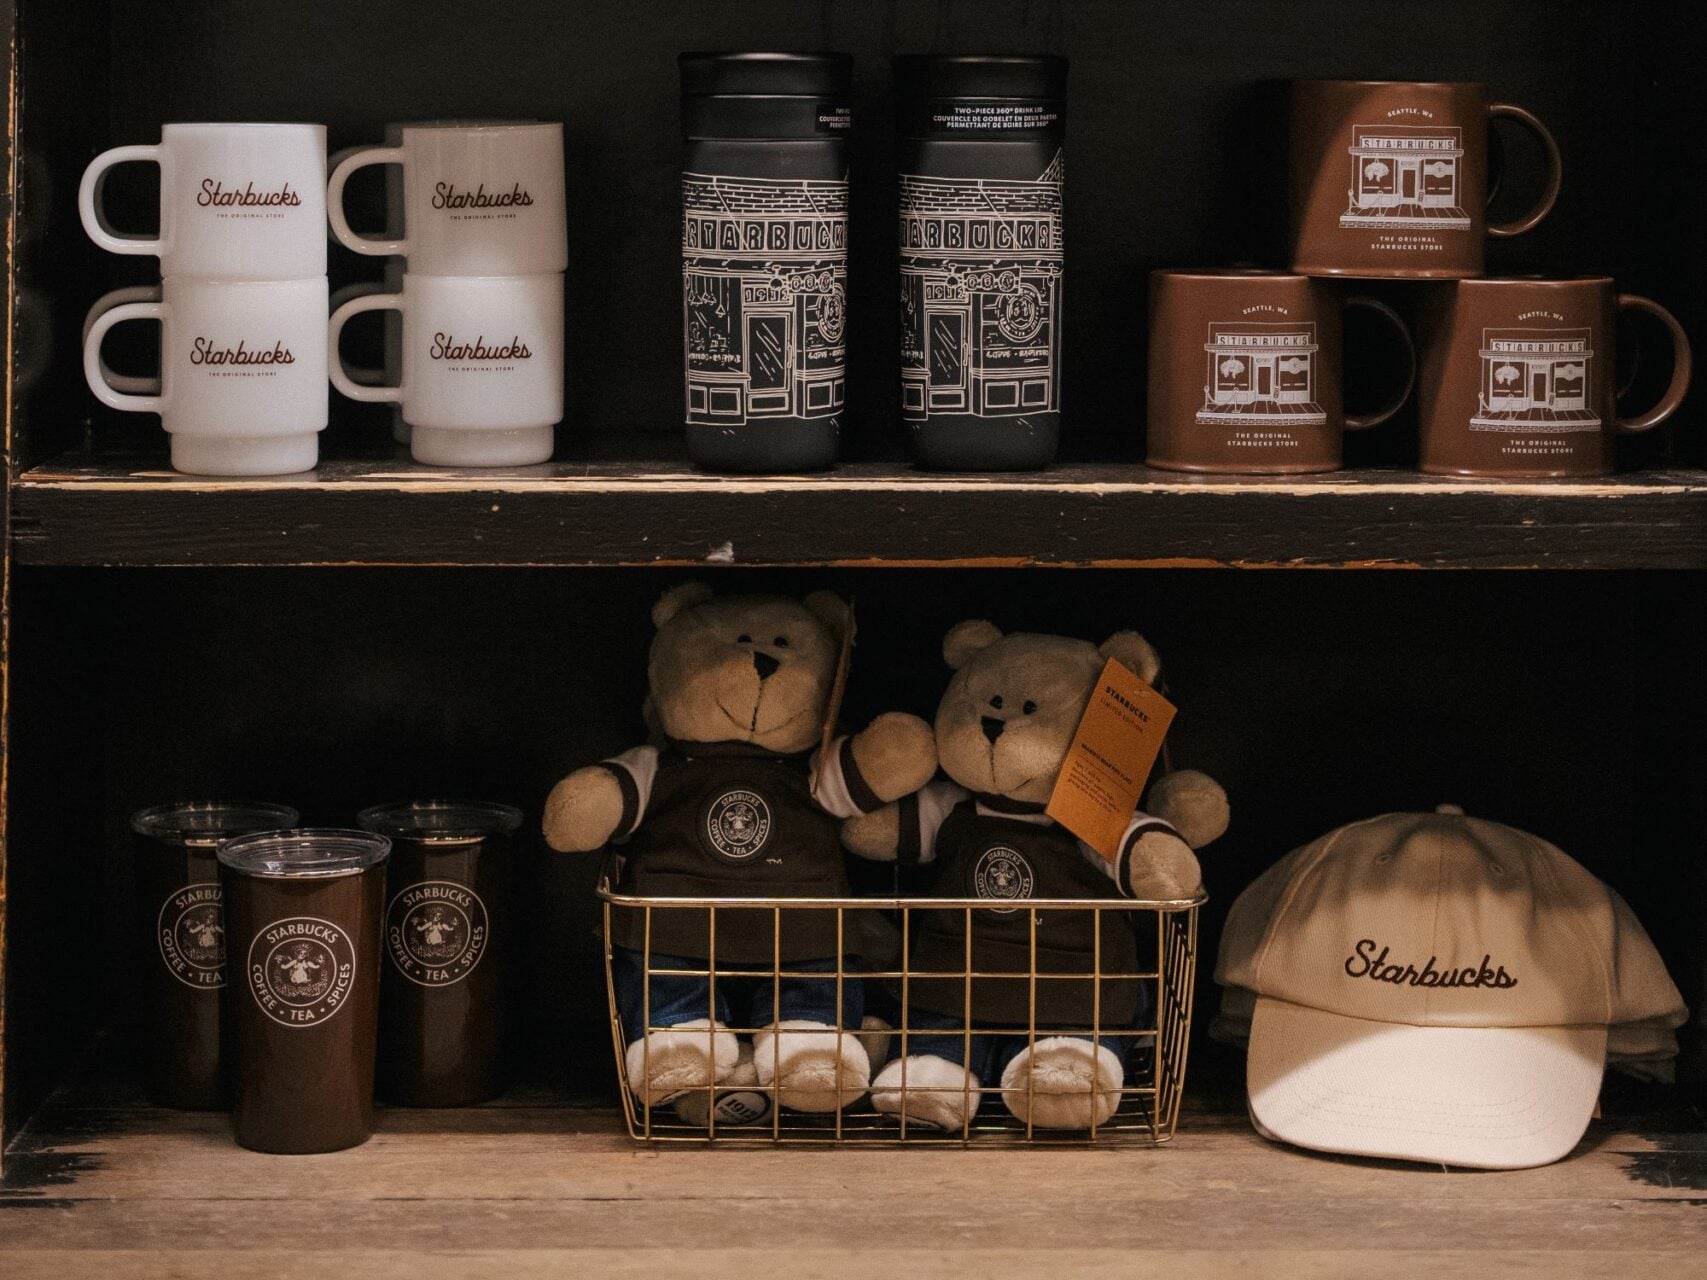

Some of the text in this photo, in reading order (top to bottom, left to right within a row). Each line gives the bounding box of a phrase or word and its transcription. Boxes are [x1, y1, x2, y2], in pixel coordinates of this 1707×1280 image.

[1387, 108, 1433, 118] SEATTLE, WA
[197, 178, 302, 207] Starbucks
[432, 182, 534, 209] Starbucks
[1243, 305, 1288, 315] SEATTLE, WA
[1518, 311, 1563, 320] SEATTLE, WA
[190, 337, 295, 365] Starbucks
[430, 332, 532, 360] Starbucks
[1105, 686, 1148, 723] STARBUCKS
[721, 793, 760, 807] STARBUCKS
[711, 818, 767, 855] COFFEE TEA SPICES
[987, 850, 1020, 865] STARBUCKS
[403, 887, 472, 907] STARBUCKS
[266, 923, 339, 943] STARBUCKS
[163, 928, 223, 983] COFFEE TEA
[390, 926, 483, 981] COFFEE TEA SPICES
[1345, 939, 1518, 989] Starbucks
[253, 963, 350, 1021] COFFEE TEA SPICES
